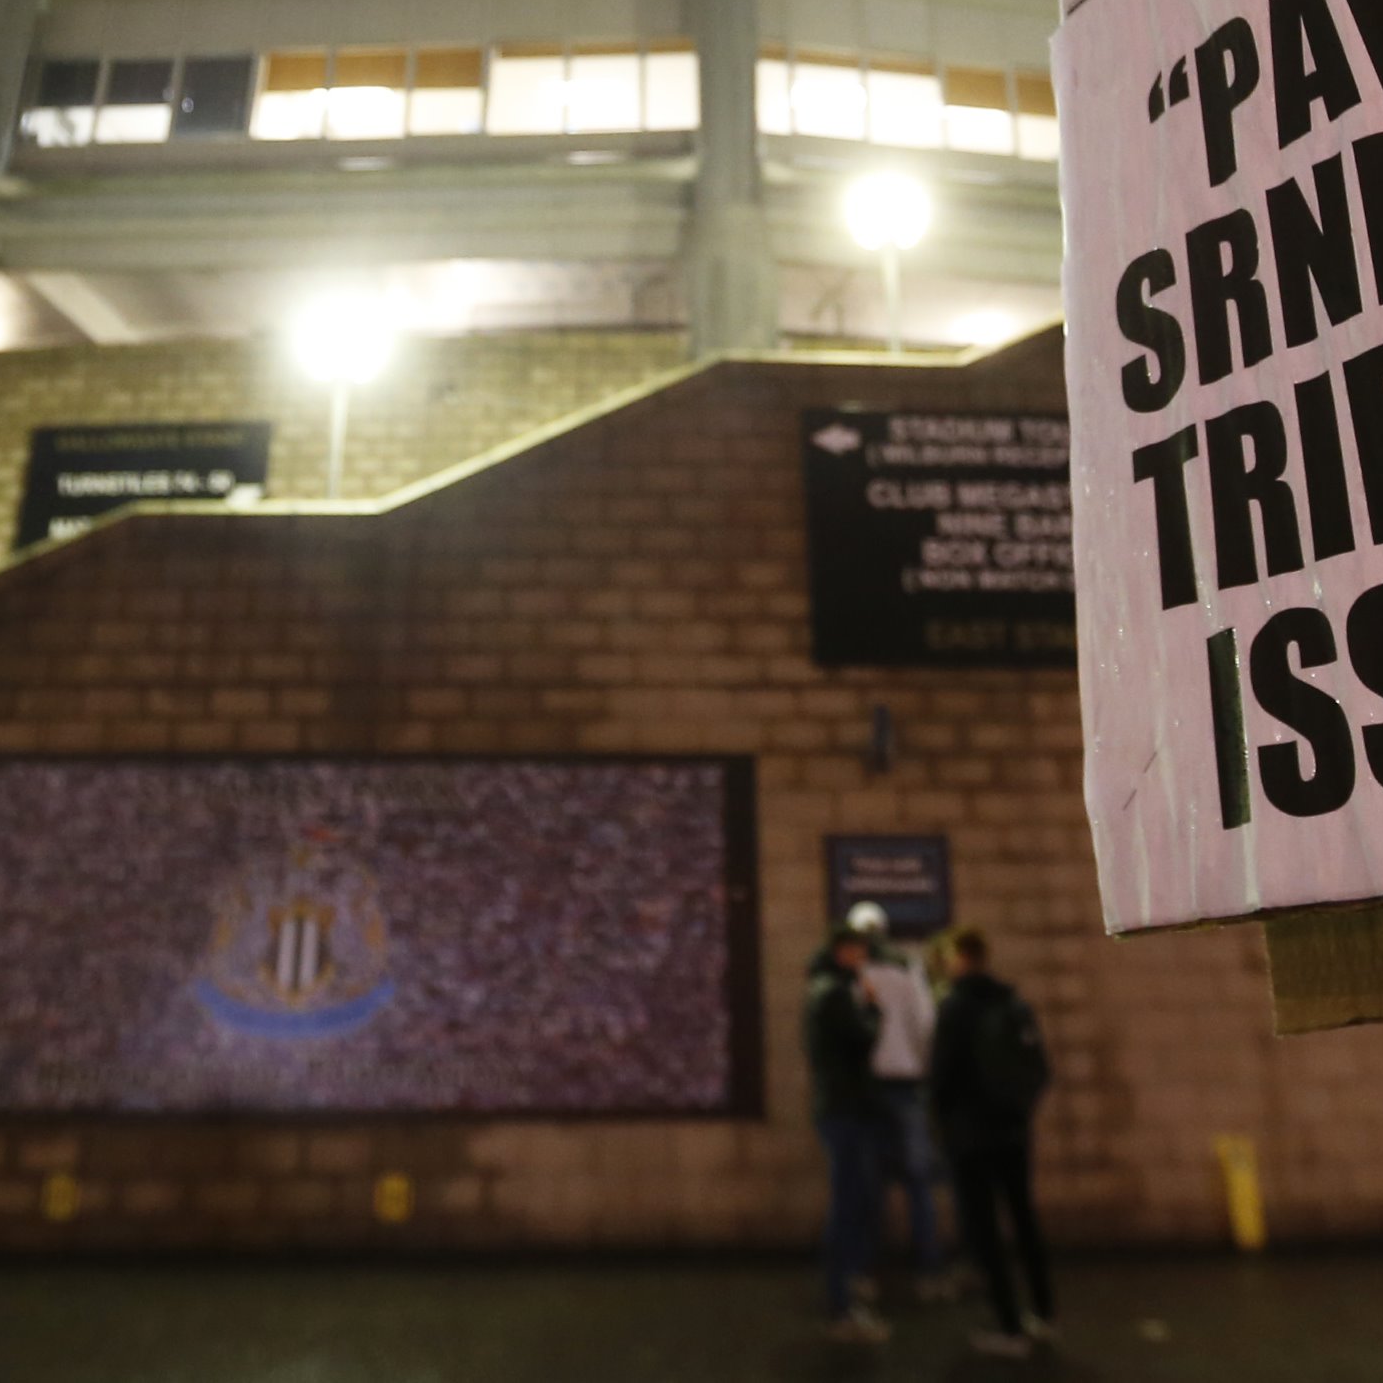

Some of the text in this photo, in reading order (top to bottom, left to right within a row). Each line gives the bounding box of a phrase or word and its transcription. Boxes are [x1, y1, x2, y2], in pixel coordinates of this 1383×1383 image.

[867, 480, 1071, 510] CLUB MEGAS
[922, 539, 988, 564] BOX
